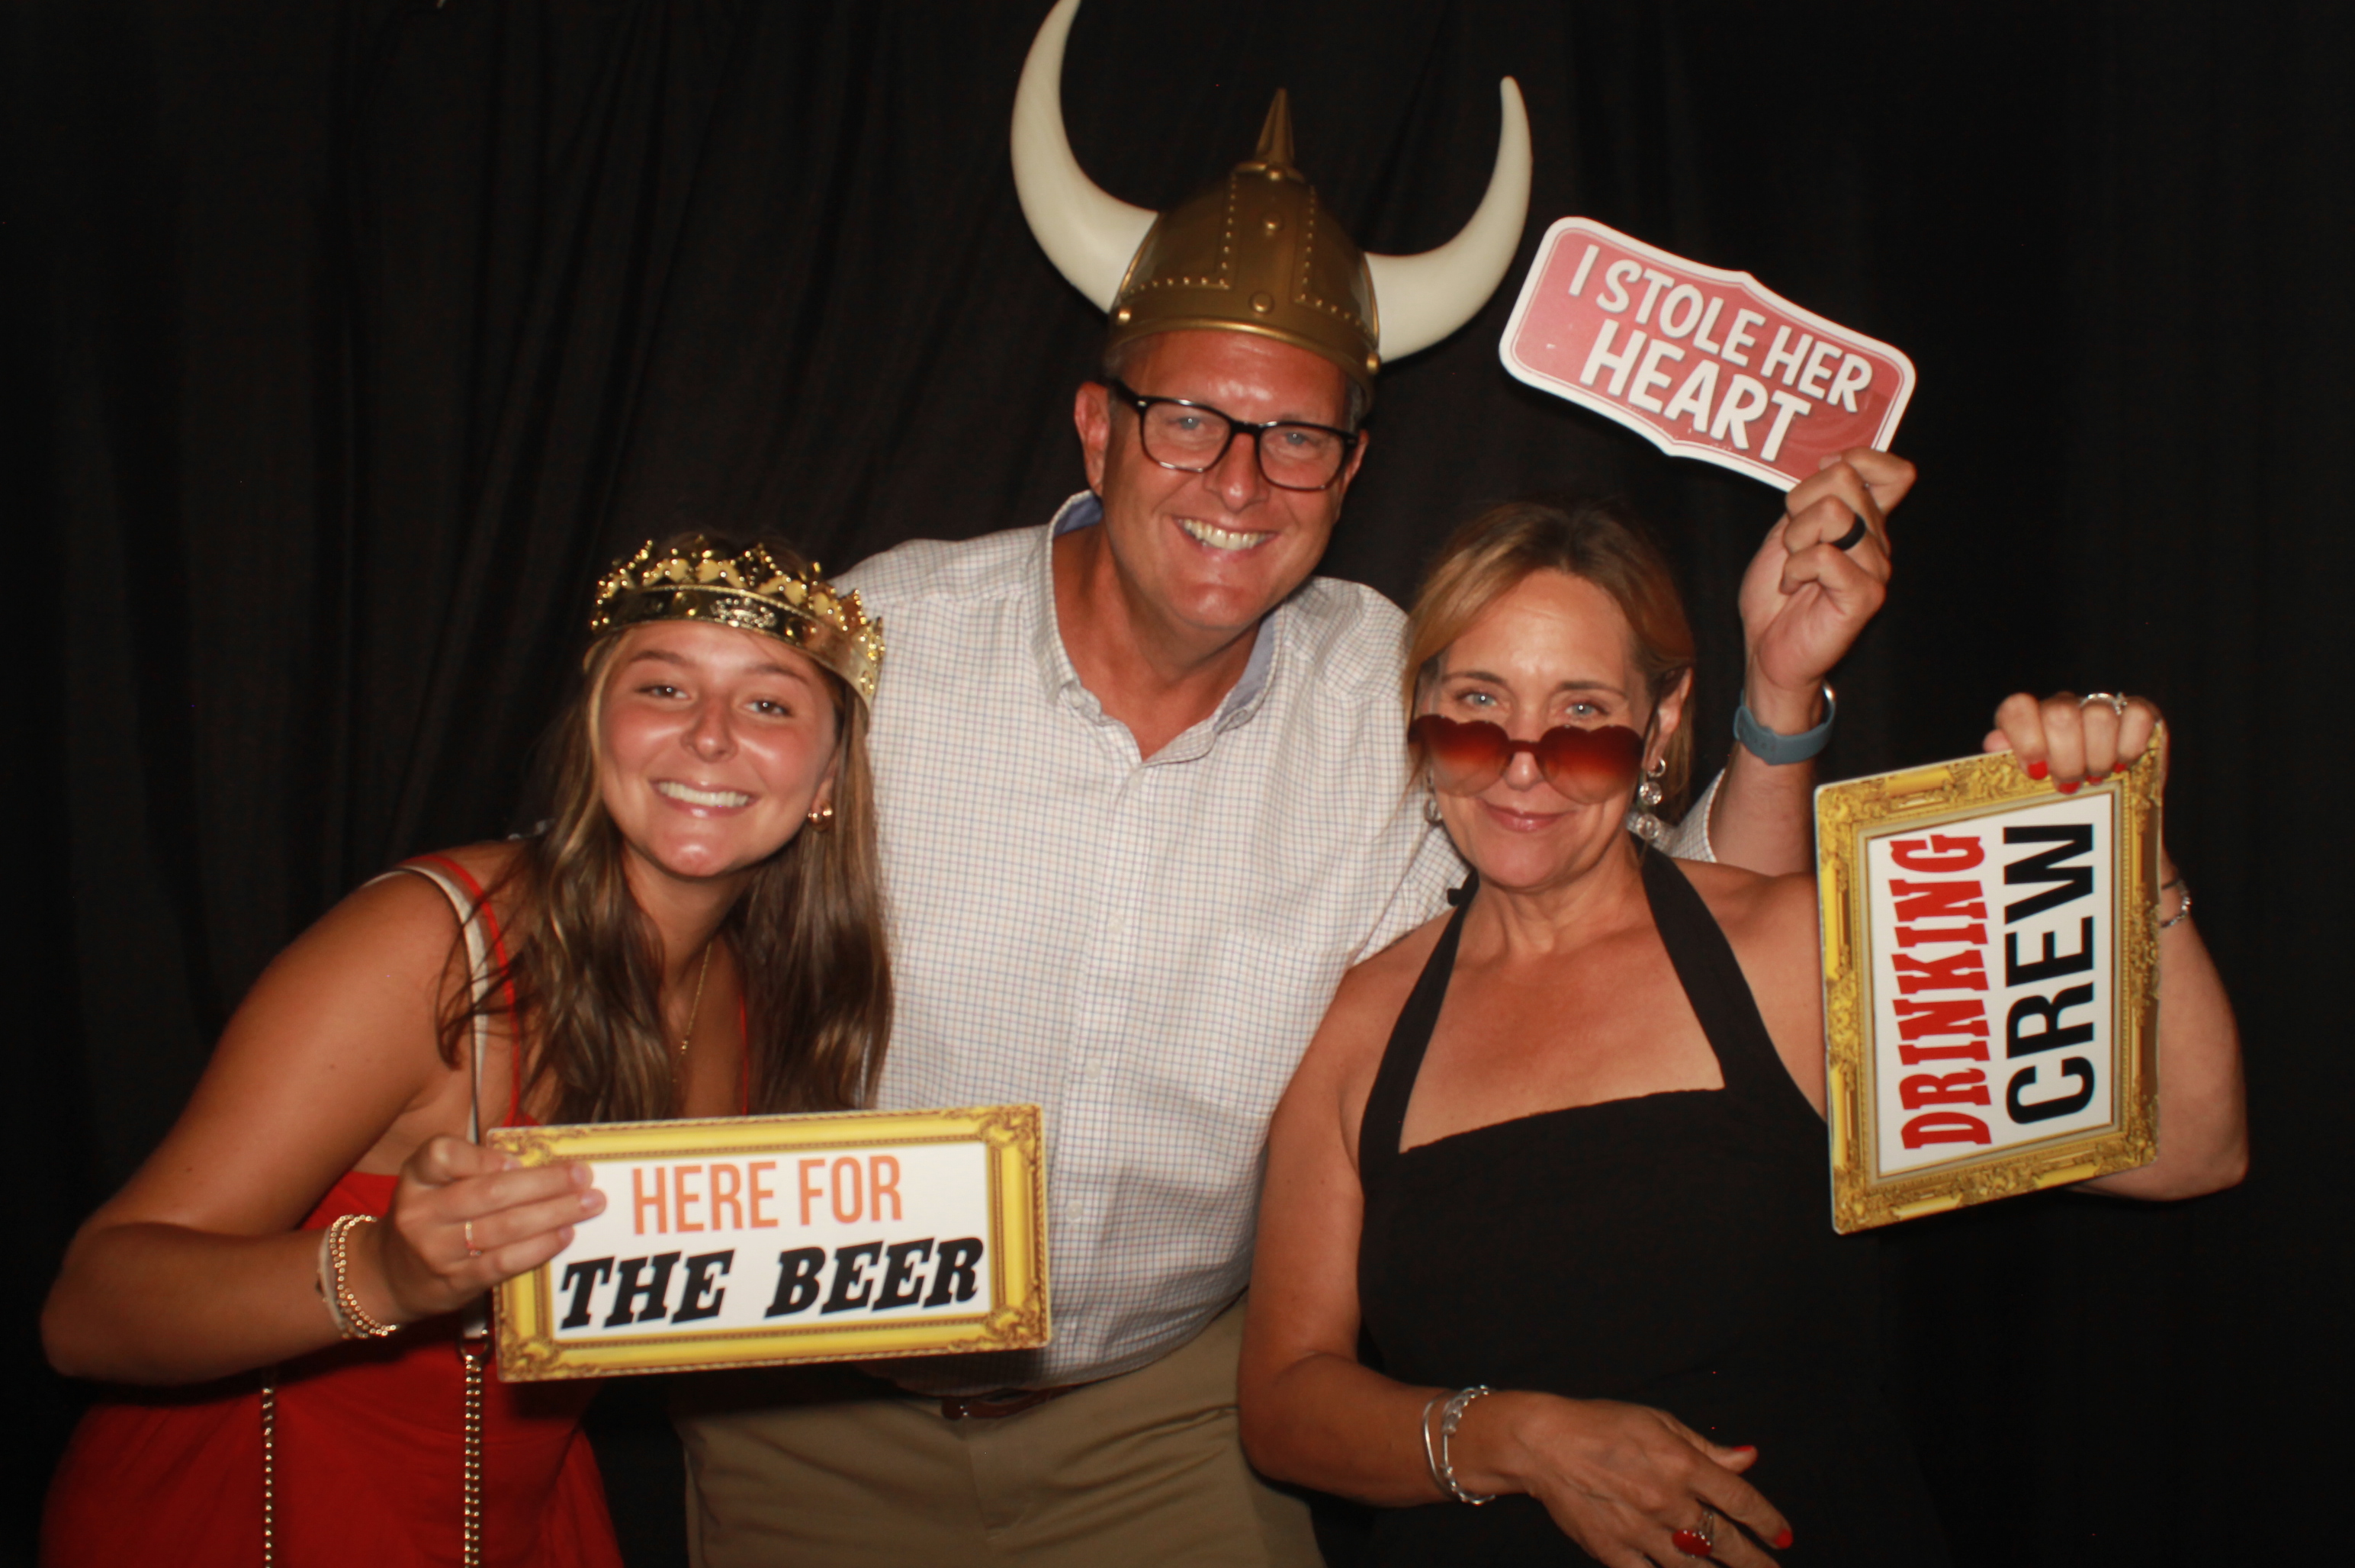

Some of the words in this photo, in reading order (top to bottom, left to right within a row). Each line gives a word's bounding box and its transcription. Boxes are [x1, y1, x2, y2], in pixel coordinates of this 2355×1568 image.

[1569, 244, 1600, 297] I
[1595, 259, 1766, 367] STOLE
[1760, 325, 1873, 413] HER
[1579, 318, 1812, 462] HEART
[1888, 834, 1993, 1149] DRINKING
[2003, 823, 2096, 1126] CREW
[631, 1161, 779, 1235] HERE
[798, 1155, 903, 1226] FOR
[559, 1248, 737, 1331] THE
[763, 1236, 985, 1319] BEER
